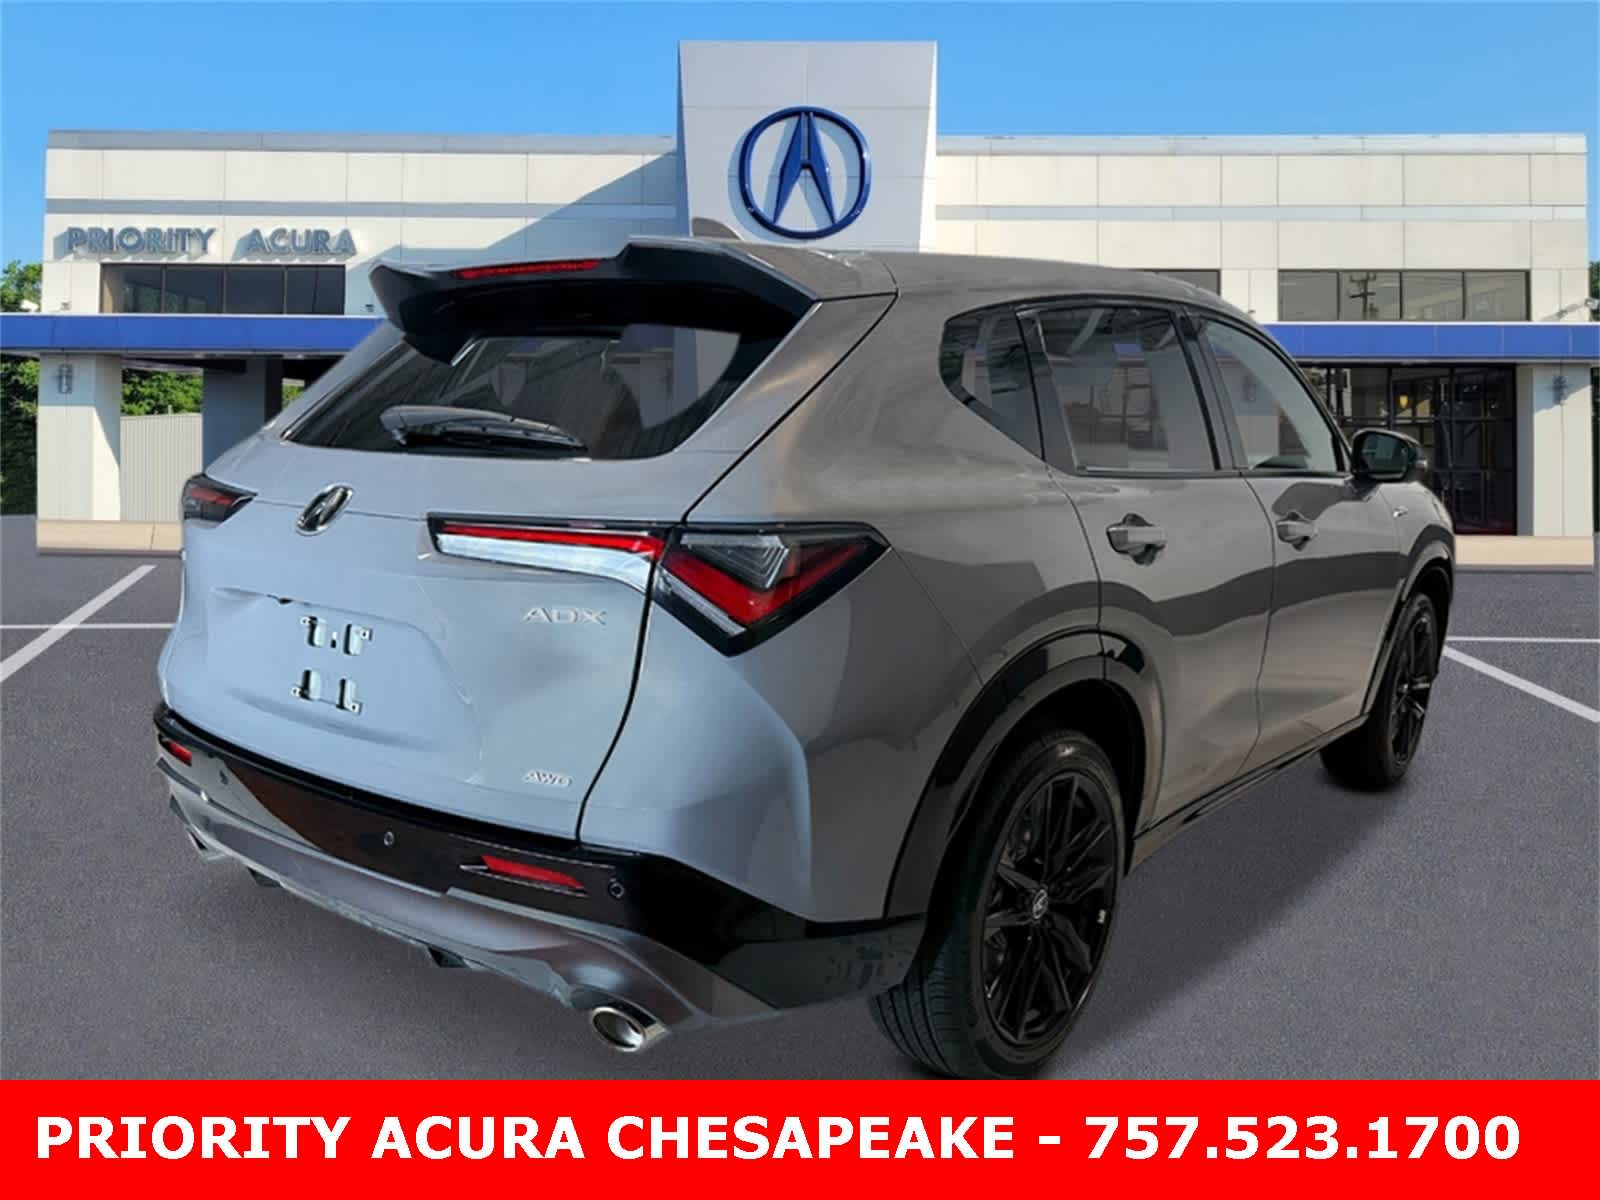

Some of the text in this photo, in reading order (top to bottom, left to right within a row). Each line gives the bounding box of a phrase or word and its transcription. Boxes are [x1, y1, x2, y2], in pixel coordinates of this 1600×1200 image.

[66, 226, 357, 255] PRIORITY ACURA
[523, 607, 607, 625] ADX
[524, 769, 573, 788] AWD
